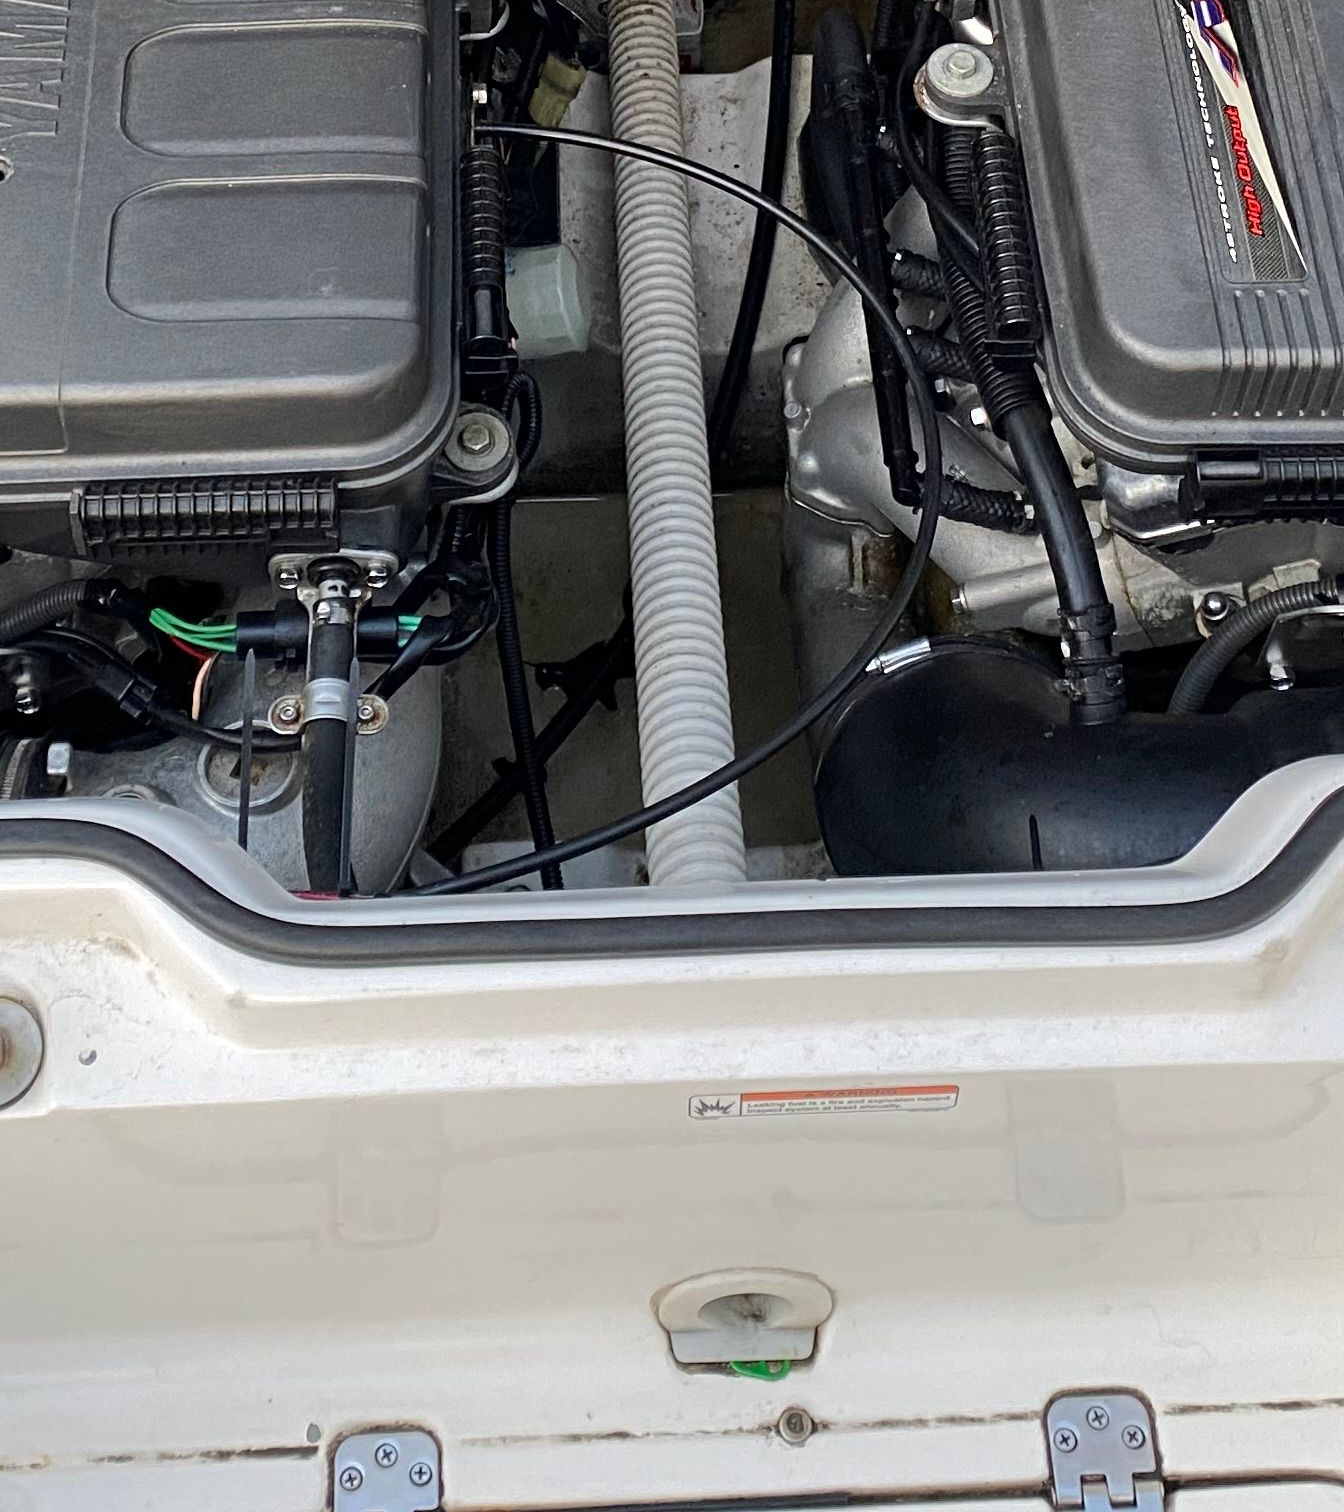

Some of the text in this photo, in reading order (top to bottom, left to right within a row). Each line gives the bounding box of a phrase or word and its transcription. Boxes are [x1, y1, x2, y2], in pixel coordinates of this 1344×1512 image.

[1174, 0, 1215, 148] TECHNOLOGY
[1223, 104, 1267, 238] High Output
